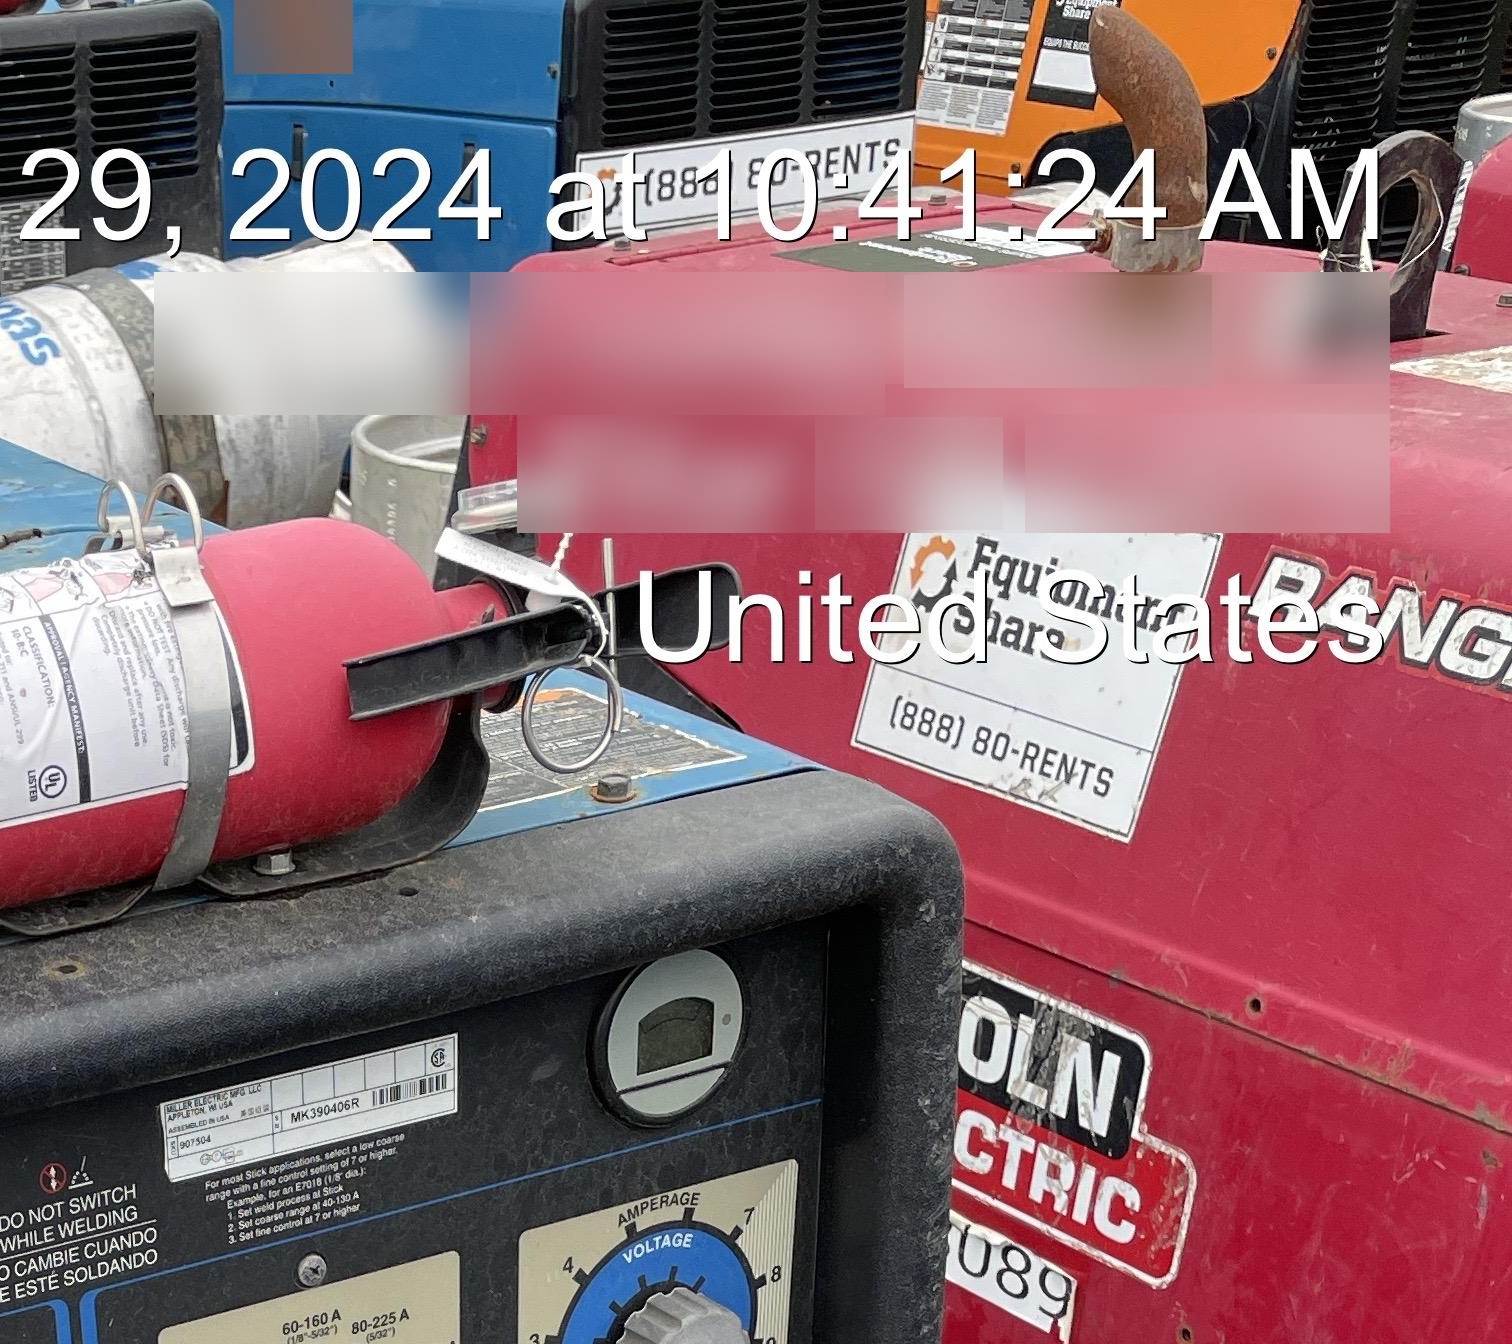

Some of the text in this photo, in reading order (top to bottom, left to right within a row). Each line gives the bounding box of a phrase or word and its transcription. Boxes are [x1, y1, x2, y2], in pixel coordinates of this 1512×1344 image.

[1246, 553, 1512, 690] RANG
[21, 625, 56, 708] CLASSIFICATION:
[888, 695, 1115, 799] (888) 80-RENTS
[166, 1084, 262, 1113] MILLER ELECTRIC LLC
[219, 1100, 233, 1110] USA
[291, 1098, 359, 1123] MK390406R
[205, 1180, 220, 1190] For
[221, 1173, 244, 1186] most
[245, 1167, 267, 1180] Stick
[324, 1146, 351, 1160] select
[359, 1141, 374, 1151] low
[376, 1133, 405, 1147] coarse
[953, 1108, 1142, 1245] CTRIC
[206, 1189, 231, 1202] range
[232, 1184, 251, 1195] with
[260, 1178, 276, 1188] fine
[278, 1168, 308, 1184] control
[310, 1162, 339, 1176] setting
[28, 1201, 65, 1224] NOT
[69, 1184, 136, 1214] SWITCH
[617, 1192, 701, 1227] AMPERAGE
[744, 1208, 756, 1225] 7
[0, 1205, 138, 1253] WHILE WELDING
[14, 1246, 80, 1277] CAMBIE
[84, 1227, 157, 1259] CUANDO
[563, 1256, 574, 1274] 4
[622, 1233, 694, 1264] VOLTAGE
[15, 1270, 60, 1299] ESTÉ
[64, 1249, 158, 1286] SOLDANDO
[770, 1266, 782, 1283] 8
[281, 1309, 342, 1336] 60-160 A
[350, 1308, 410, 1335] 80-225 A
